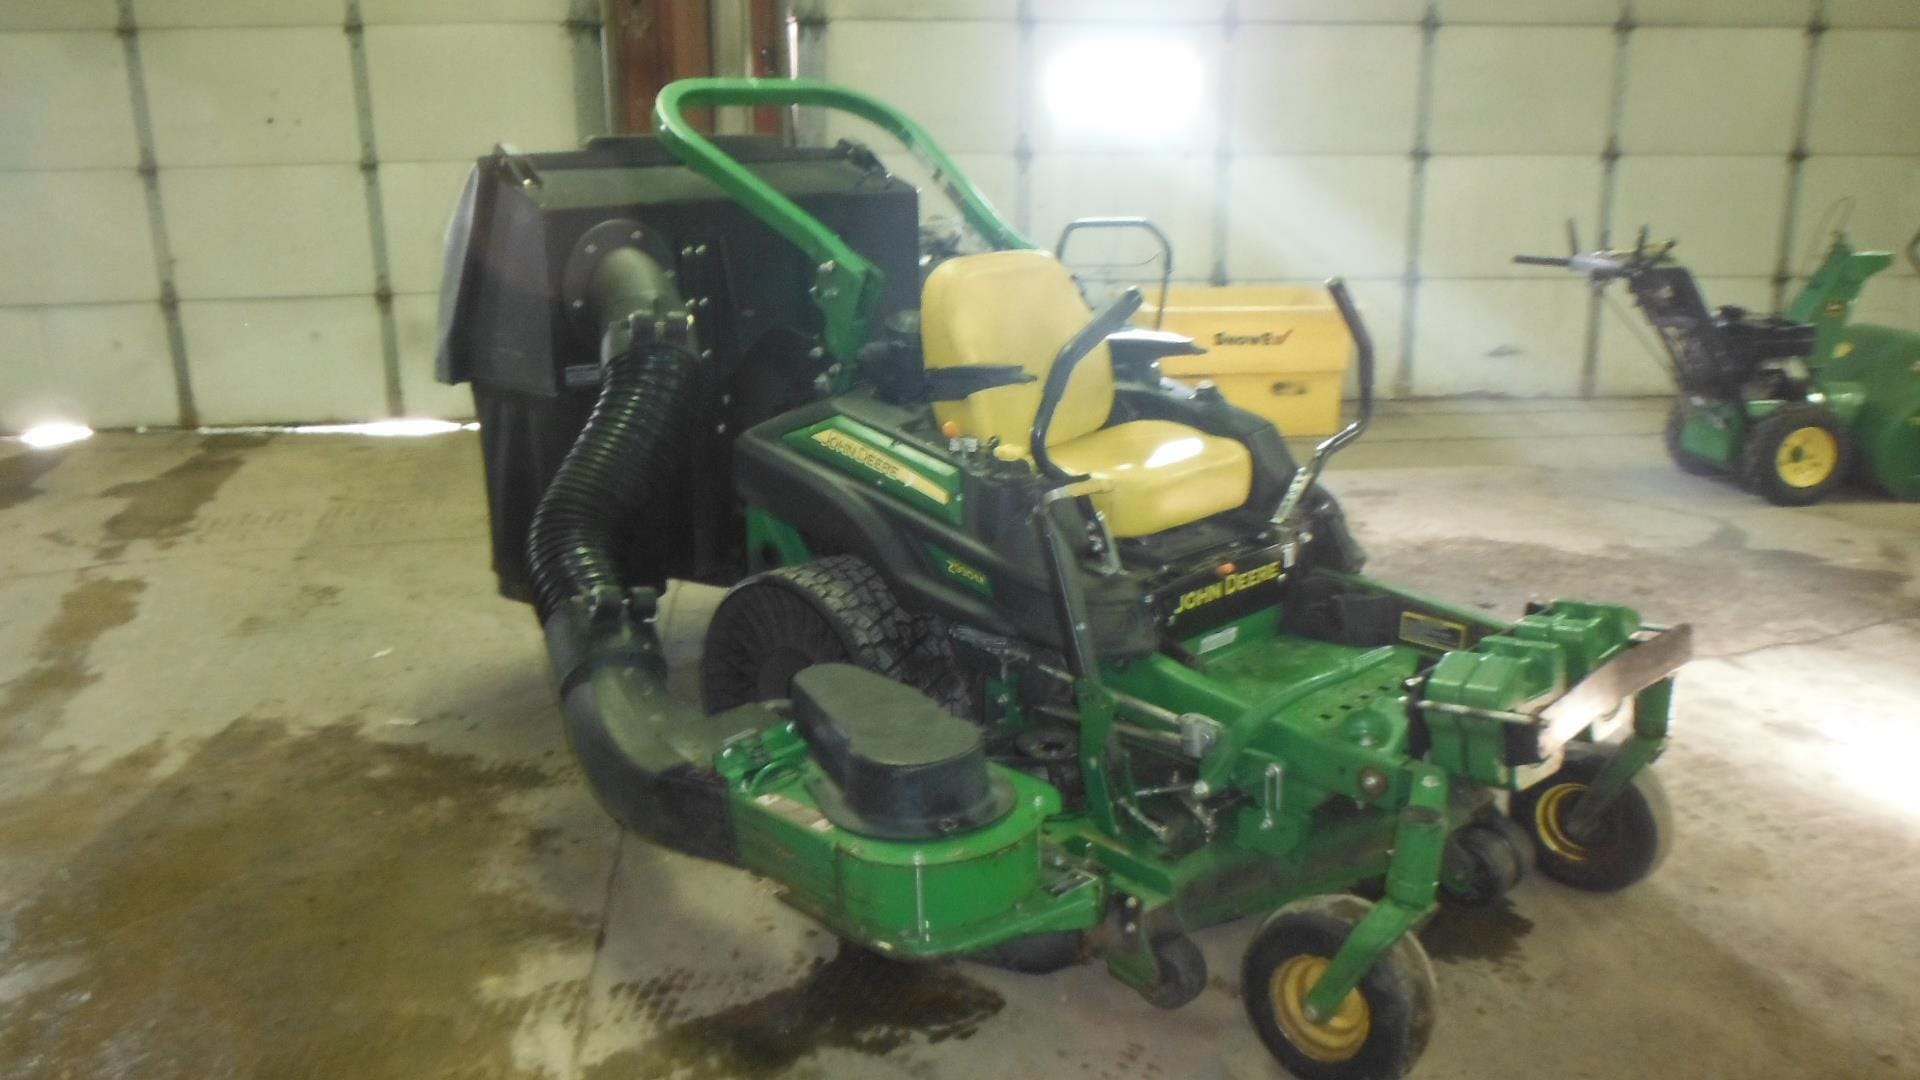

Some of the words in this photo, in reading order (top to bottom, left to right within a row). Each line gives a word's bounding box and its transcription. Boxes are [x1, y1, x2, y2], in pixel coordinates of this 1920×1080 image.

[824, 432, 857, 459] JOHN
[856, 447, 900, 479] DEERE
[1173, 582, 1224, 614] JOHN
[1224, 561, 1280, 595] DEERE
